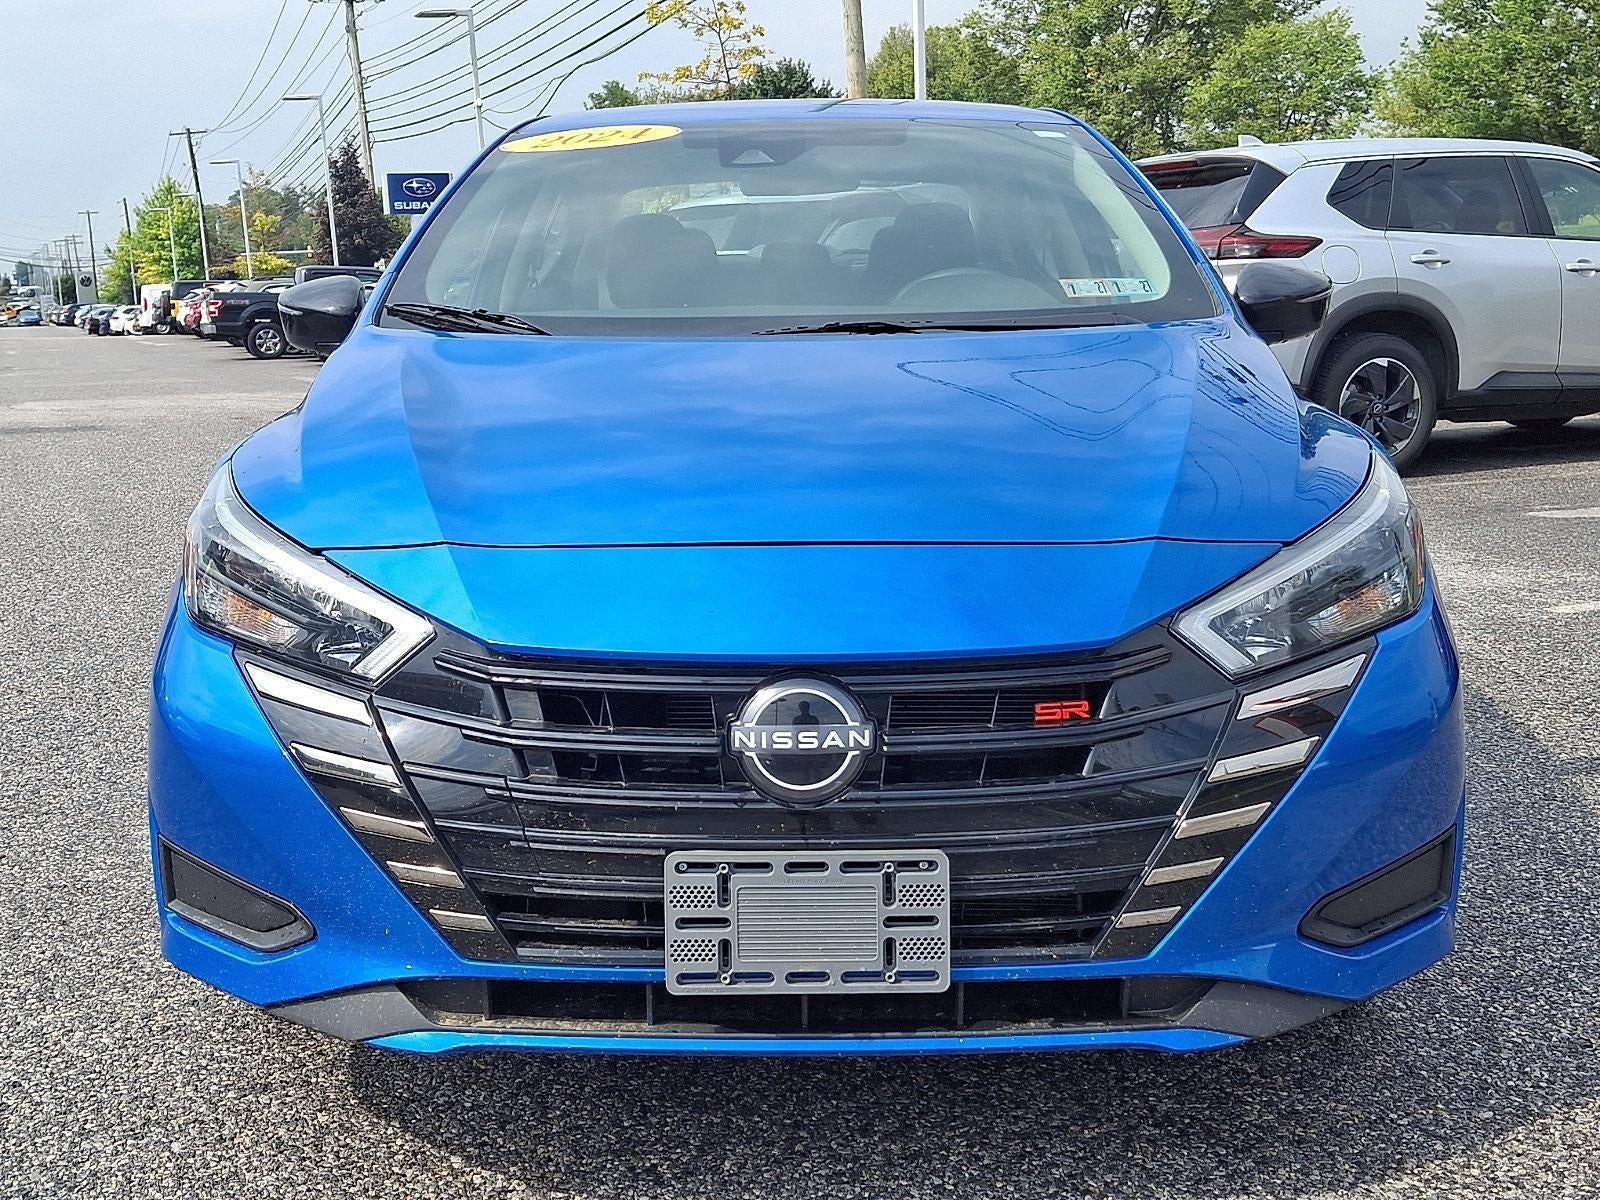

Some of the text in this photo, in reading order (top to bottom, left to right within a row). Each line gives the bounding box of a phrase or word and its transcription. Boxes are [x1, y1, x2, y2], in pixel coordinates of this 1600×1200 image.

[1094, 281, 1108, 294] 27
[1139, 280, 1153, 293] 27
[1035, 700, 1090, 721] SR
[734, 729, 870, 749] NISSAN
